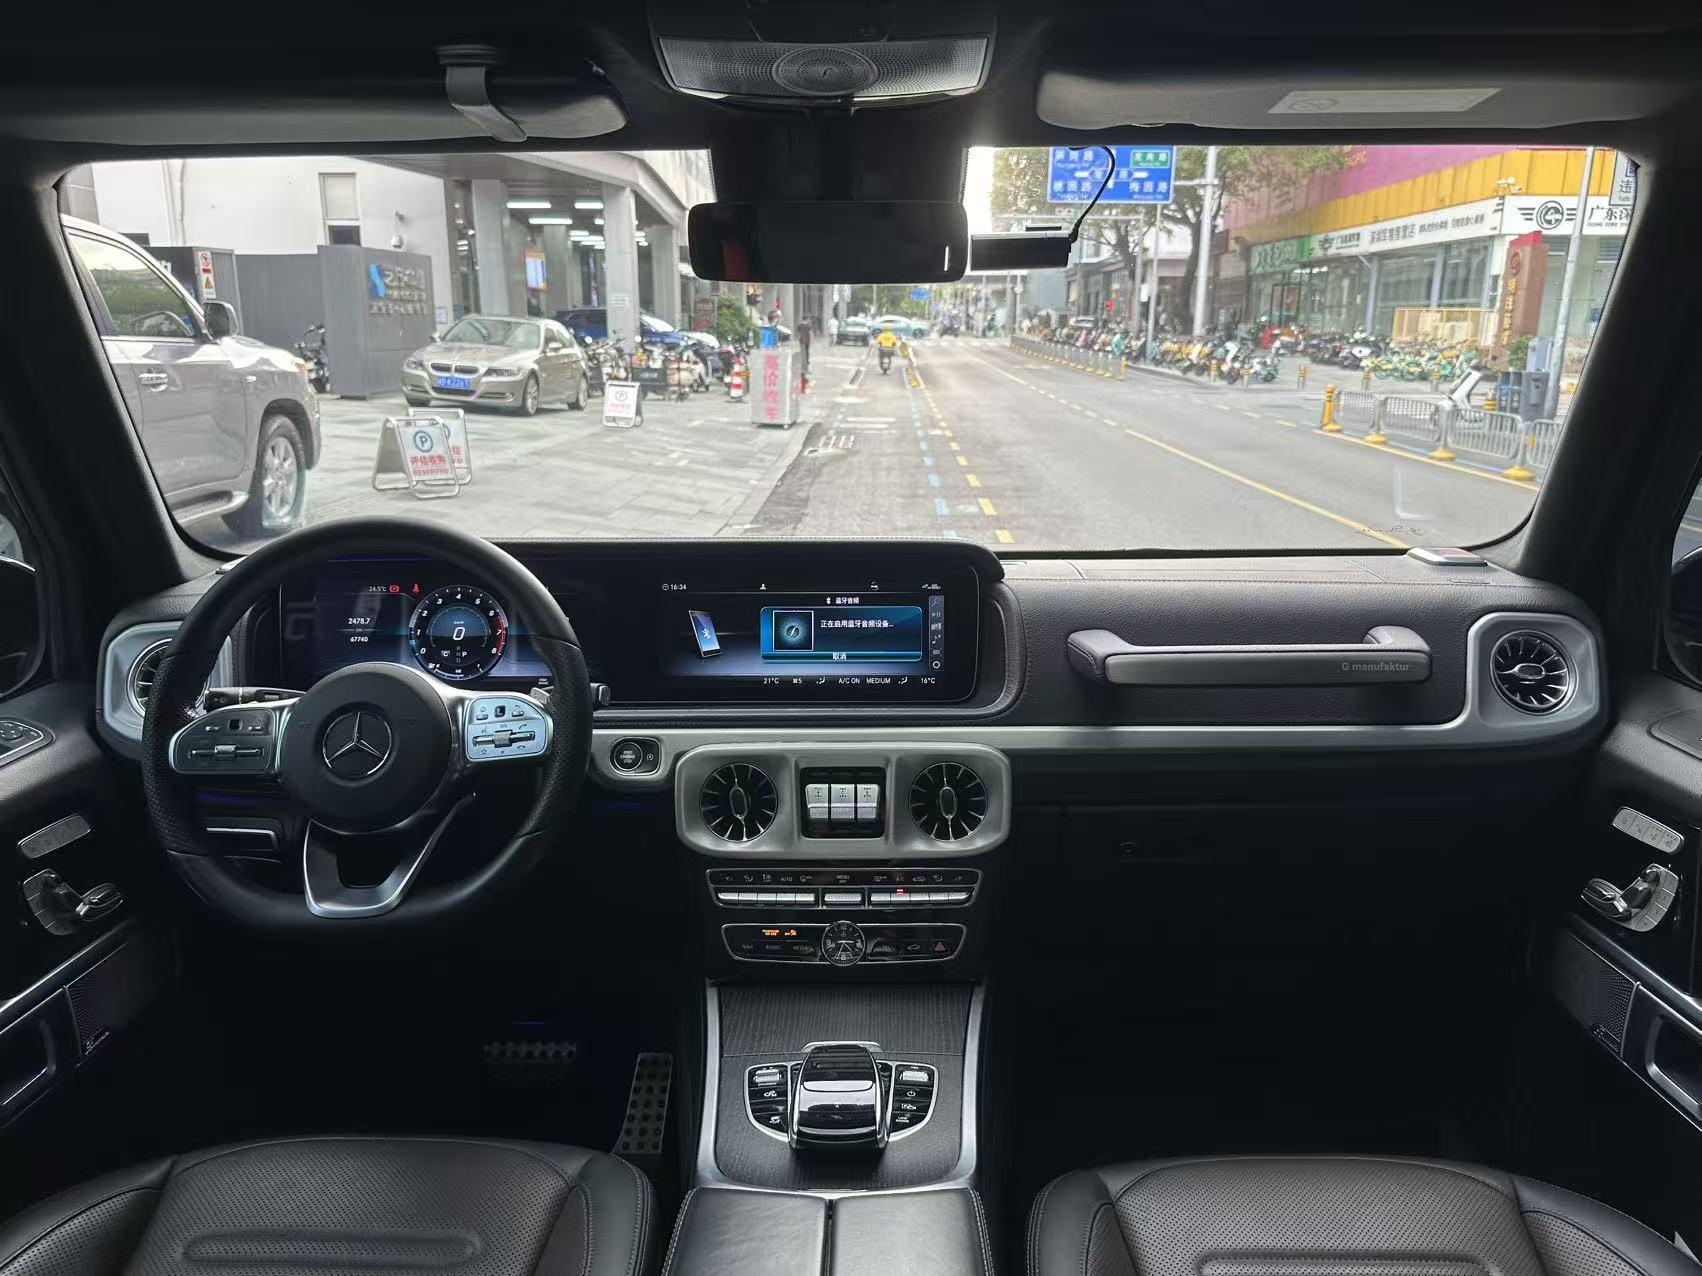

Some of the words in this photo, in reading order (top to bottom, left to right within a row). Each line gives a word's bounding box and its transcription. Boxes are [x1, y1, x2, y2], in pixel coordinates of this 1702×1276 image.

[452, 626, 466, 641] 0
[832, 652, 847, 660] 取消
[1341, 662, 1350, 671] G
[1352, 661, 1410, 671] manufaktur
